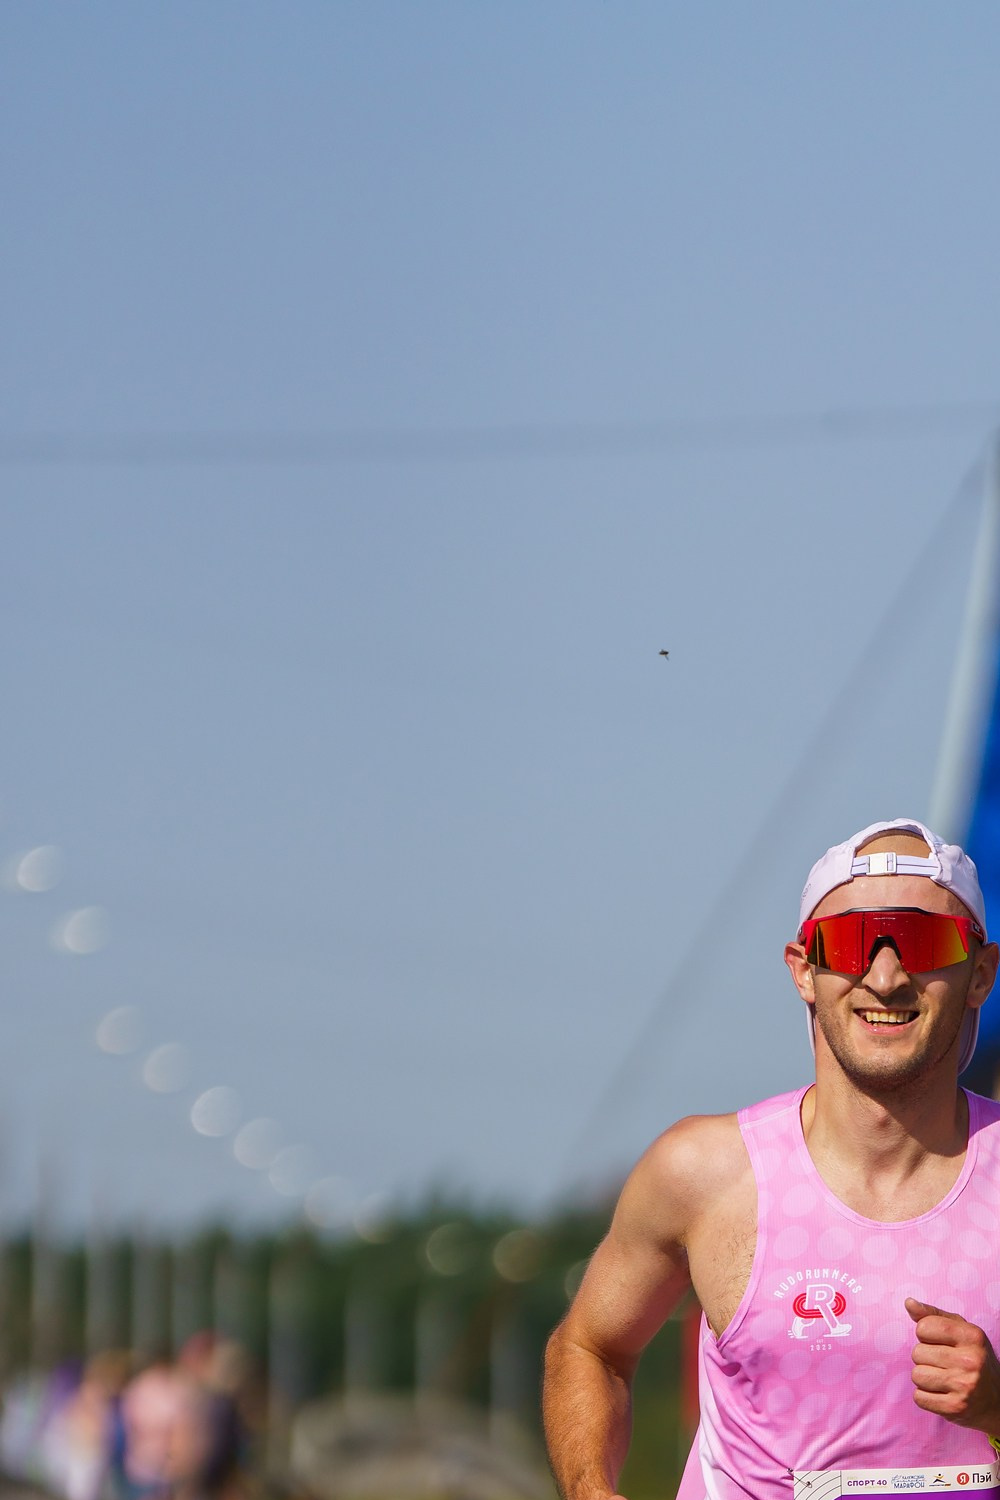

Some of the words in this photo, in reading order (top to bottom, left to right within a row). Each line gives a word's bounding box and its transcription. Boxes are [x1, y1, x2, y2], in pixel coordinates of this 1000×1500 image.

[773, 1268, 862, 1299] RUDORUNNERS
[847, 1479, 875, 1487] СПОРТ
[972, 1472, 992, 1484] Пэй
